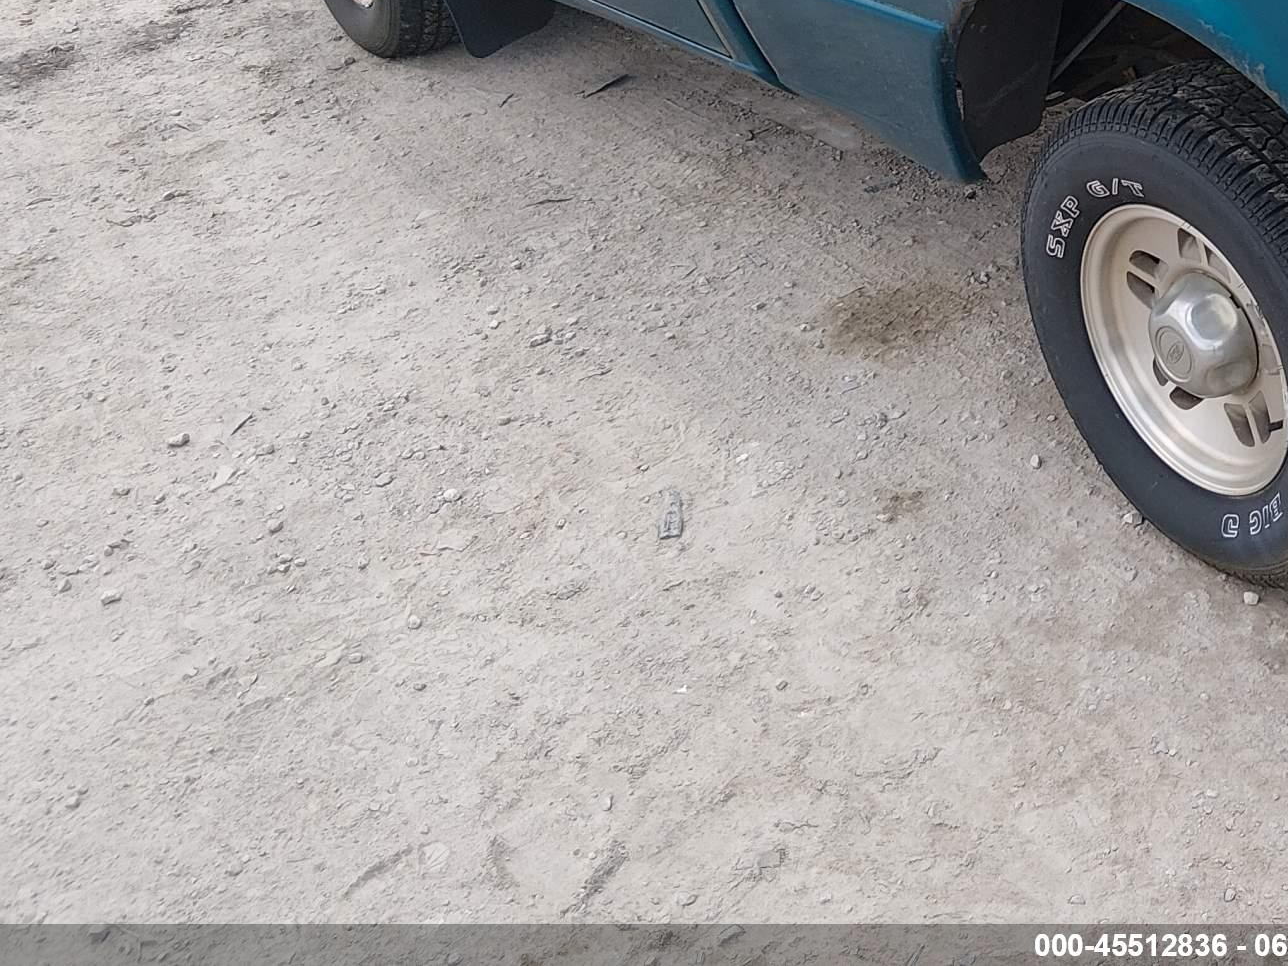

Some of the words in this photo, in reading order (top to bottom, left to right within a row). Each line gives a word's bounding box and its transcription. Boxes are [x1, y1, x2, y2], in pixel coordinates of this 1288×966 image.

[1045, 195, 1080, 259] SXP
[1085, 177, 1145, 198] G/T
[1249, 491, 1283, 535] BIG
